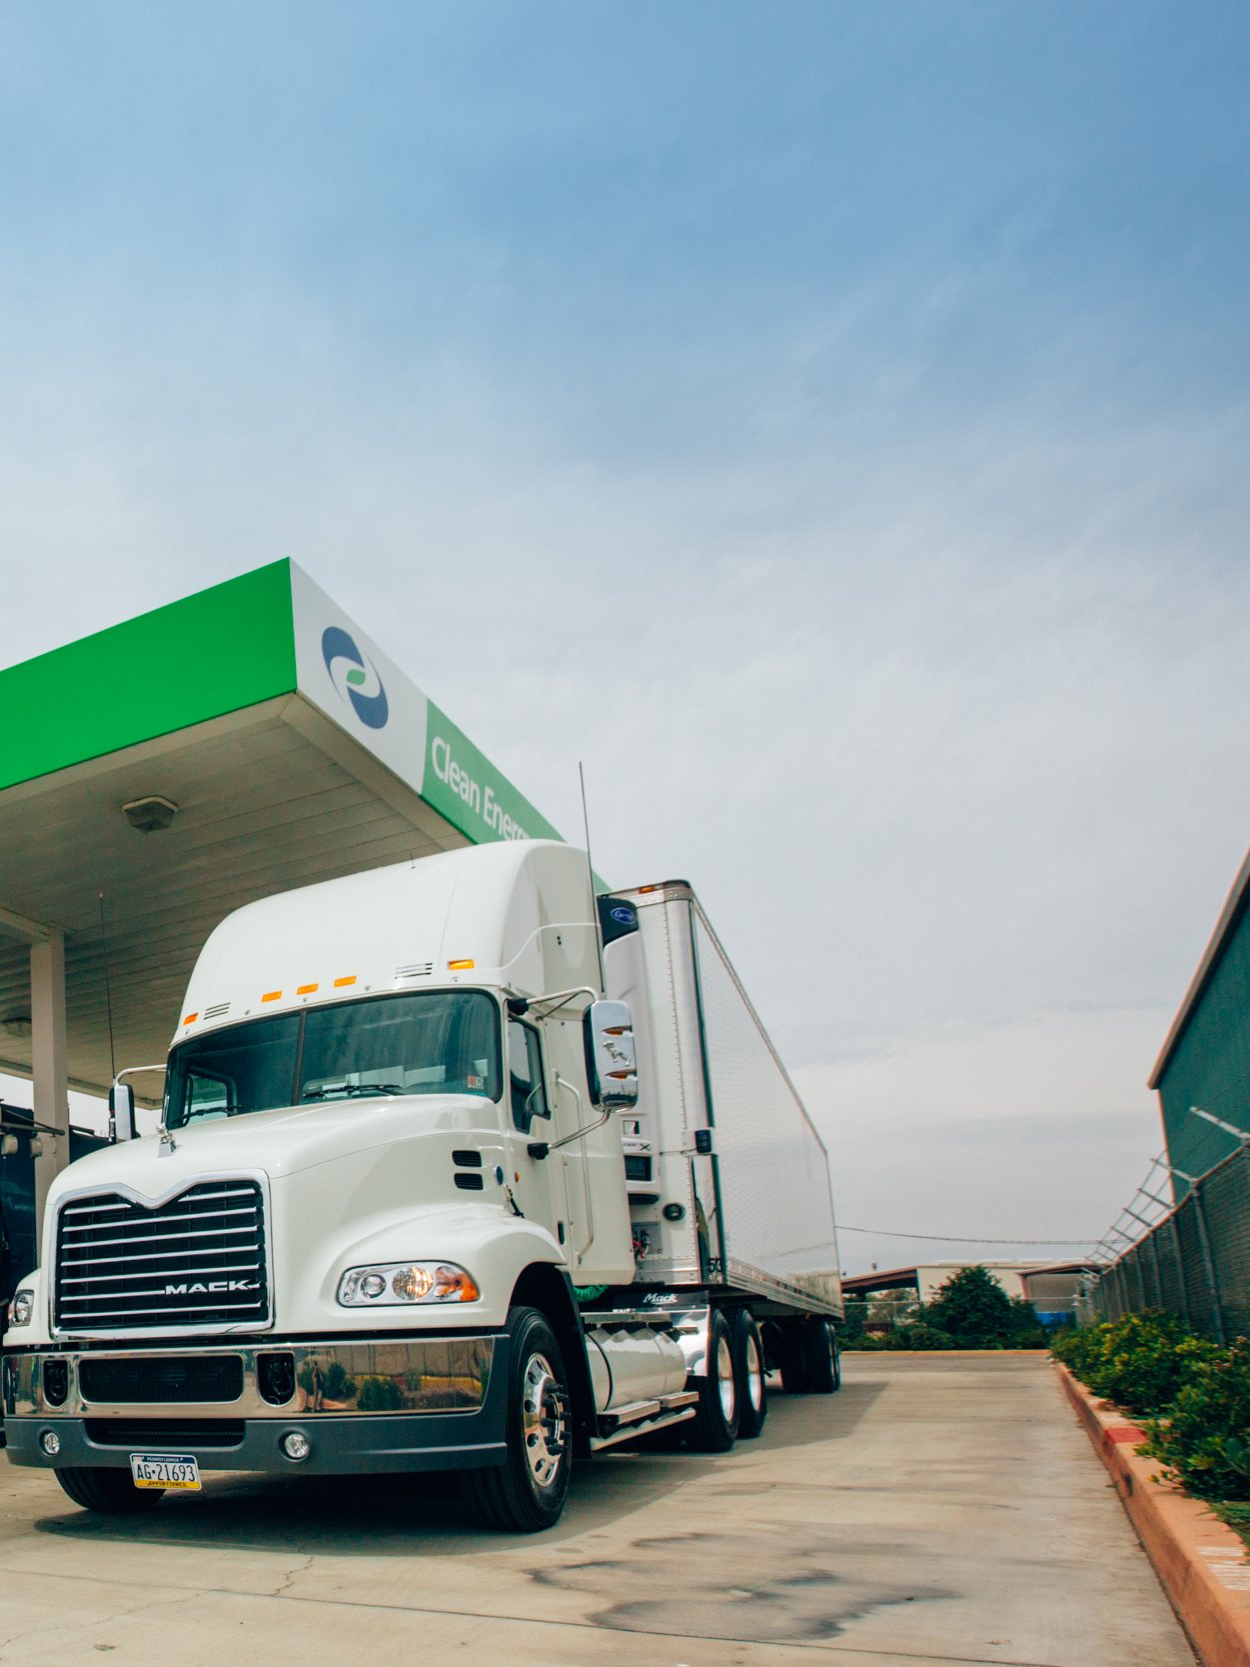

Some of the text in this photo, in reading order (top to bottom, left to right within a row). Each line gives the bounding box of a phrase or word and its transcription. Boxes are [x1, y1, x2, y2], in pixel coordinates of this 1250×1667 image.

[432, 736, 480, 814] Clean
[165, 1279, 250, 1295] MACK
[642, 1293, 678, 1305] Mack
